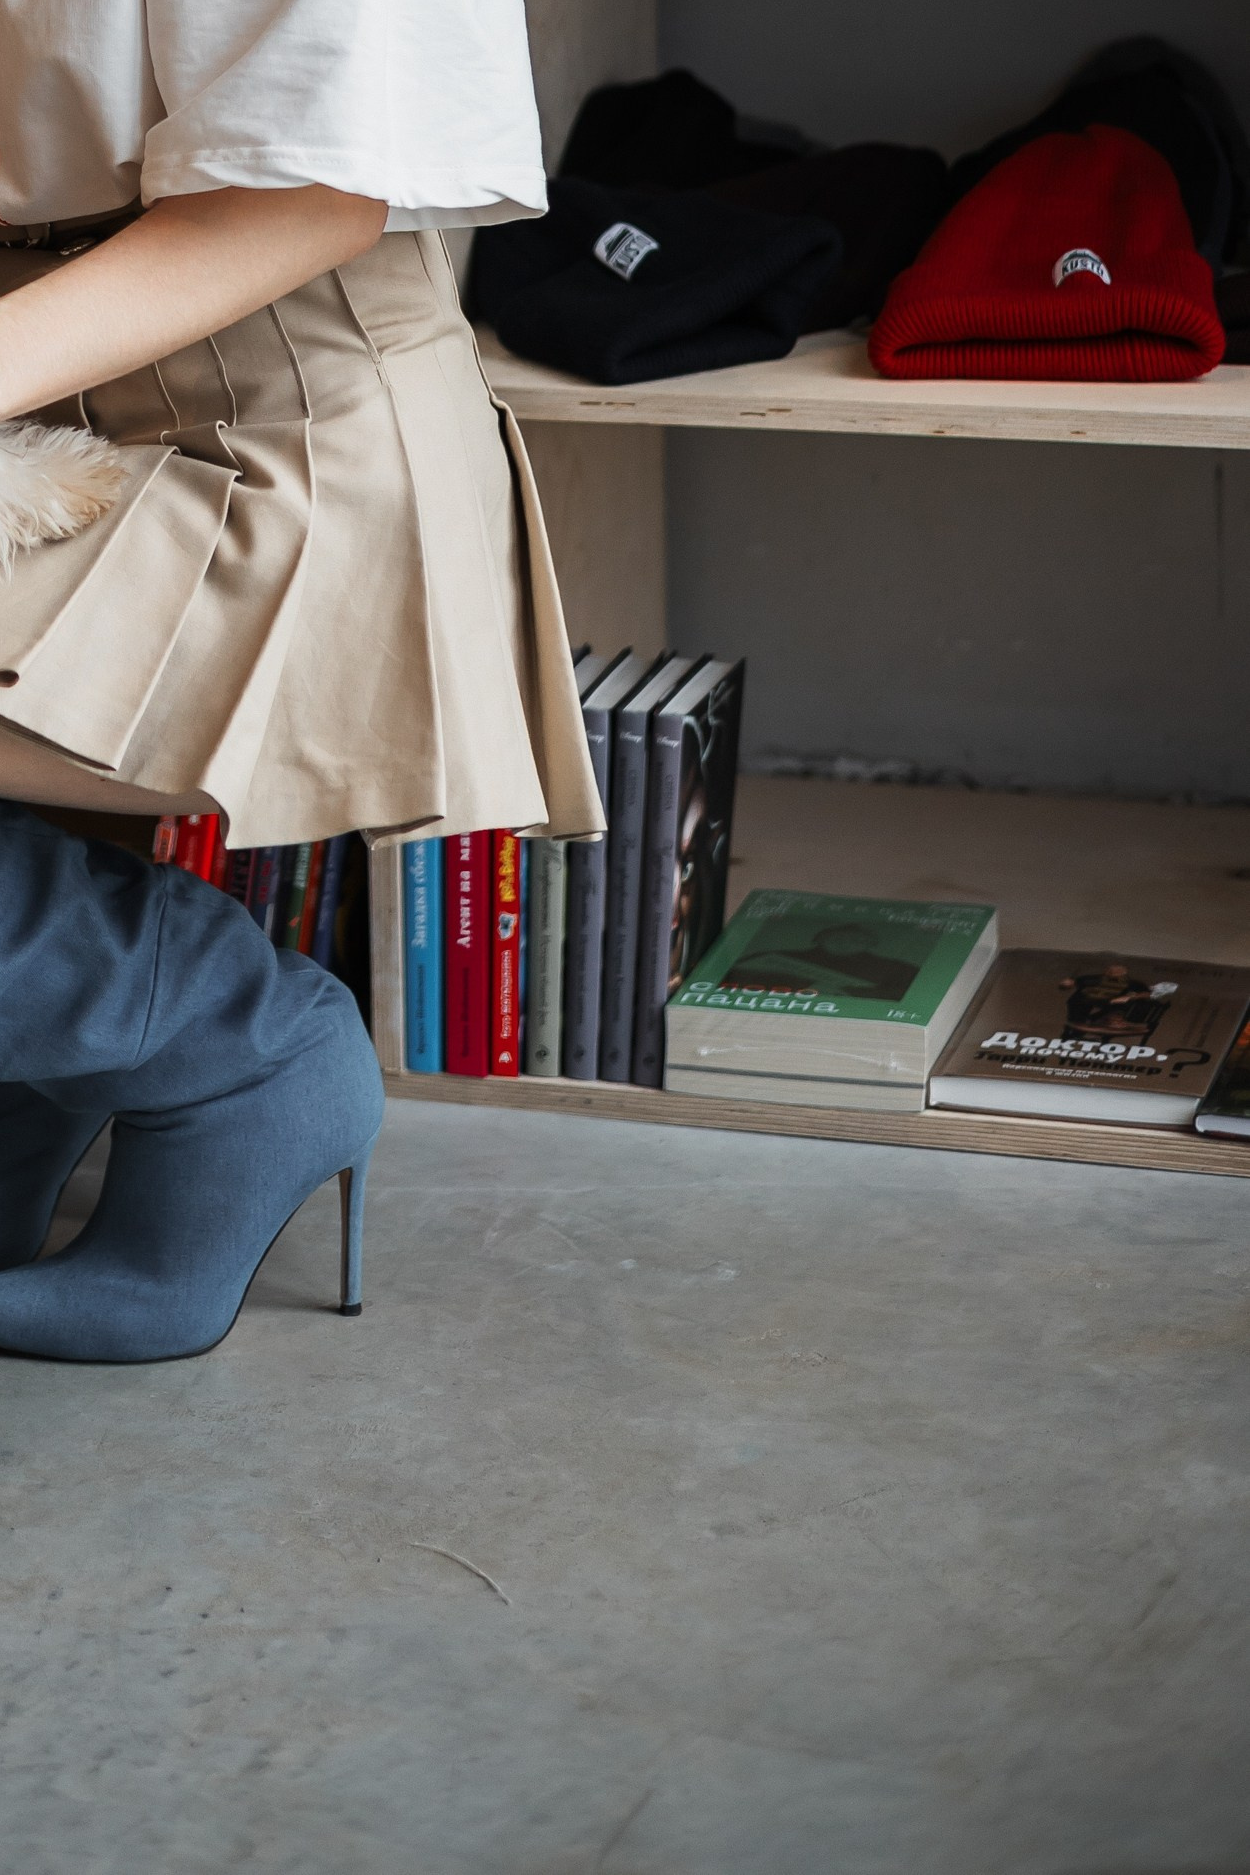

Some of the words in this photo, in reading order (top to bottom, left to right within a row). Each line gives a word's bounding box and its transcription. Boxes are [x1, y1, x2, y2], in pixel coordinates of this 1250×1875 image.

[1062, 257, 1104, 276] KUSTO
[458, 870, 471, 893] на
[410, 887, 427, 949] Загадка
[456, 898, 473, 948] Агент
[689, 981, 819, 998] слово
[680, 992, 840, 1014] пацана
[980, 1031, 1169, 1063] Доктор,
[1019, 1046, 1124, 1063] почему
